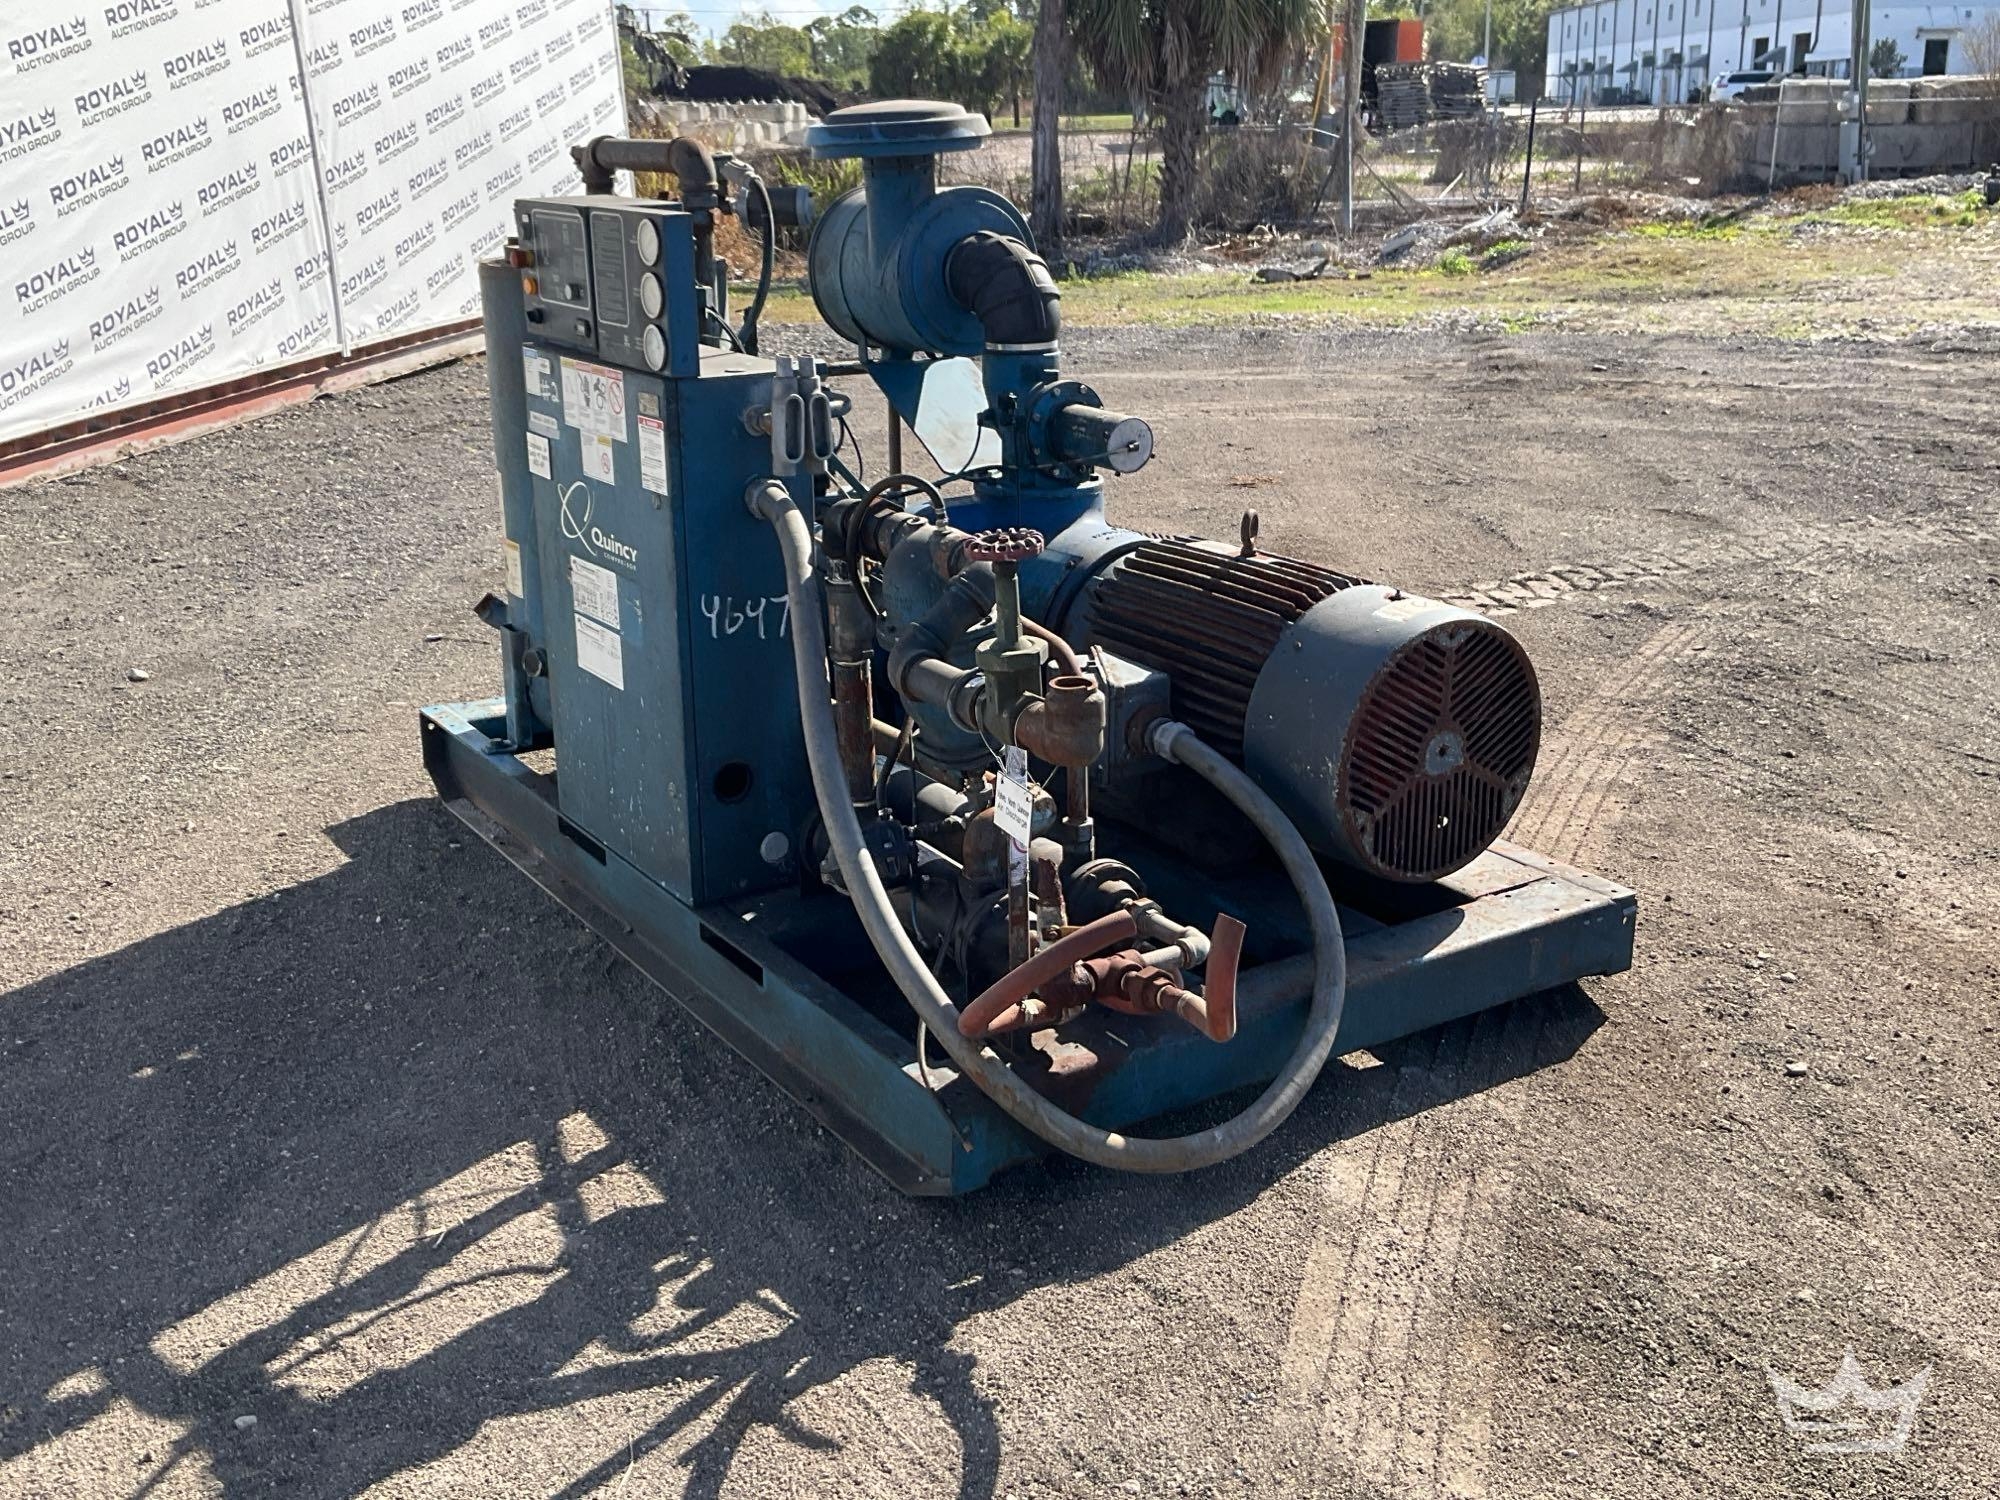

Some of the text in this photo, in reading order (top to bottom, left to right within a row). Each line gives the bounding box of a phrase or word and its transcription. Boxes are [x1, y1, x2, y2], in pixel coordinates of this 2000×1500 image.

[110, 8, 178, 39] AUCTION GROUP
[239, 18, 285, 46] ROYAL
[349, 21, 387, 47] ROYAL
[7, 24, 76, 59] ROYAL
[14, 38, 92, 74] AUCTION GROUP
[305, 45, 331, 67] YAL
[436, 39, 467, 63] ROYAL
[163, 46, 218, 78] ROYAL
[168, 58, 231, 91] AUCTION GROUP
[388, 62, 422, 88] ROYAL
[73, 78, 136, 114] ROYAL
[333, 89, 372, 117] ROYAL
[470, 75, 498, 99] ROYAL
[80, 91, 151, 128] AUCTION GROUP
[222, 91, 270, 123] ROYAL
[425, 99, 457, 125] ROYAL
[0, 115, 42, 148] YAL
[0, 129, 62, 165] TION GROUP
[141, 125, 199, 161] ROYAL
[374, 126, 410, 155] ROYAL
[455, 135, 485, 161] ROYAL
[146, 136, 212, 174] AUCTION GROUP
[325, 157, 357, 184] OYAL
[49, 164, 114, 204] ROYAL
[196, 170, 248, 205] ROYAL
[327, 177, 349, 196] CTION
[409, 163, 441, 191] ROYAL
[486, 167, 515, 193] ROYAL
[55, 175, 129, 218] AUCTION GROUP
[201, 180, 260, 217] AUCTION GROUP
[357, 195, 393, 225] ROYAL
[441, 196, 472, 223] ROYAL
[0, 220, 36, 246] GROUP
[112, 210, 173, 250] ROYAL
[118, 220, 187, 263] AUCTION GROUP
[250, 208, 296, 243] ROYAL
[470, 226, 501, 255] ROYAL
[395, 228, 428, 258] ROYAL
[14, 257, 84, 302] ROYAL
[175, 249, 228, 288] ROYAL
[180, 258, 240, 301] AUCTION GROUP
[294, 250, 331, 281] ROYA
[340, 263, 379, 296] ROYAL
[427, 260, 456, 290] ROYAL
[21, 267, 100, 316] AUCTION GROUP
[226, 288, 273, 326] ROYAL
[89, 297, 149, 340] ROYAL
[377, 296, 412, 328] ROYAL
[93, 305, 162, 353] AUCTION GROUP
[277, 320, 320, 358] ROYAL
[0, 351, 55, 395] OYAL
[39, 359, 75, 387] GROUP
[146, 335, 203, 378] ROYAL
[151, 342, 216, 391] AUCTION GROUP
[591, 527, 637, 562] Quincy
[701, 593, 791, 639] 4647
